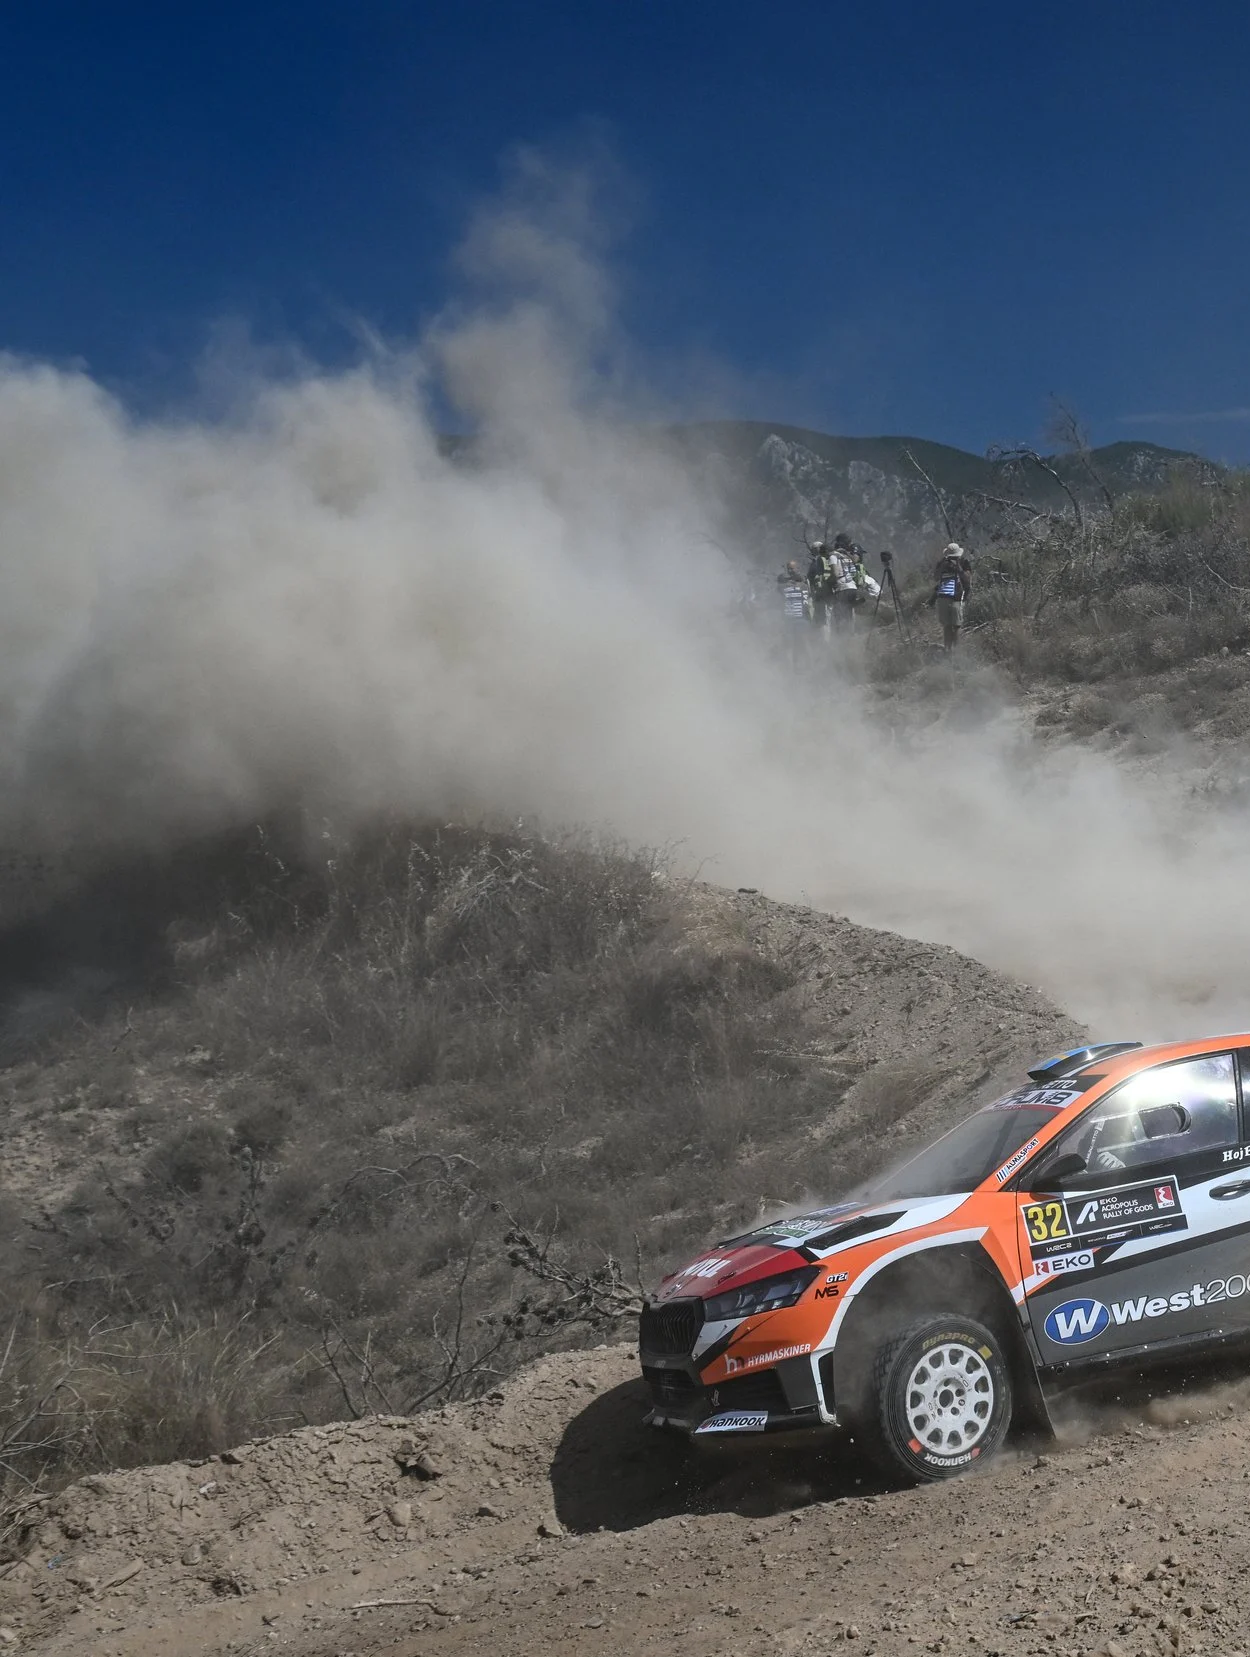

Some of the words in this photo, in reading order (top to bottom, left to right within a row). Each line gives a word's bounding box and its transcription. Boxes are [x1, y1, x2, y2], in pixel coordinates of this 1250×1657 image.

[1006, 1138, 1039, 1170] ALMASPORT
[1100, 1196, 1118, 1204] EKO
[1101, 1199, 1138, 1213] ACROPOLIS
[1102, 1210, 1123, 1219] RALLY
[1124, 1207, 1134, 1216] OF
[1134, 1203, 1154, 1214] GODS
[1027, 1202, 1067, 1241] 32
[1046, 1242, 1072, 1253] WRC2
[1052, 1254, 1091, 1271] EKO
[815, 1286, 839, 1299] MS
[748, 1344, 811, 1367] HYRMASKINER
